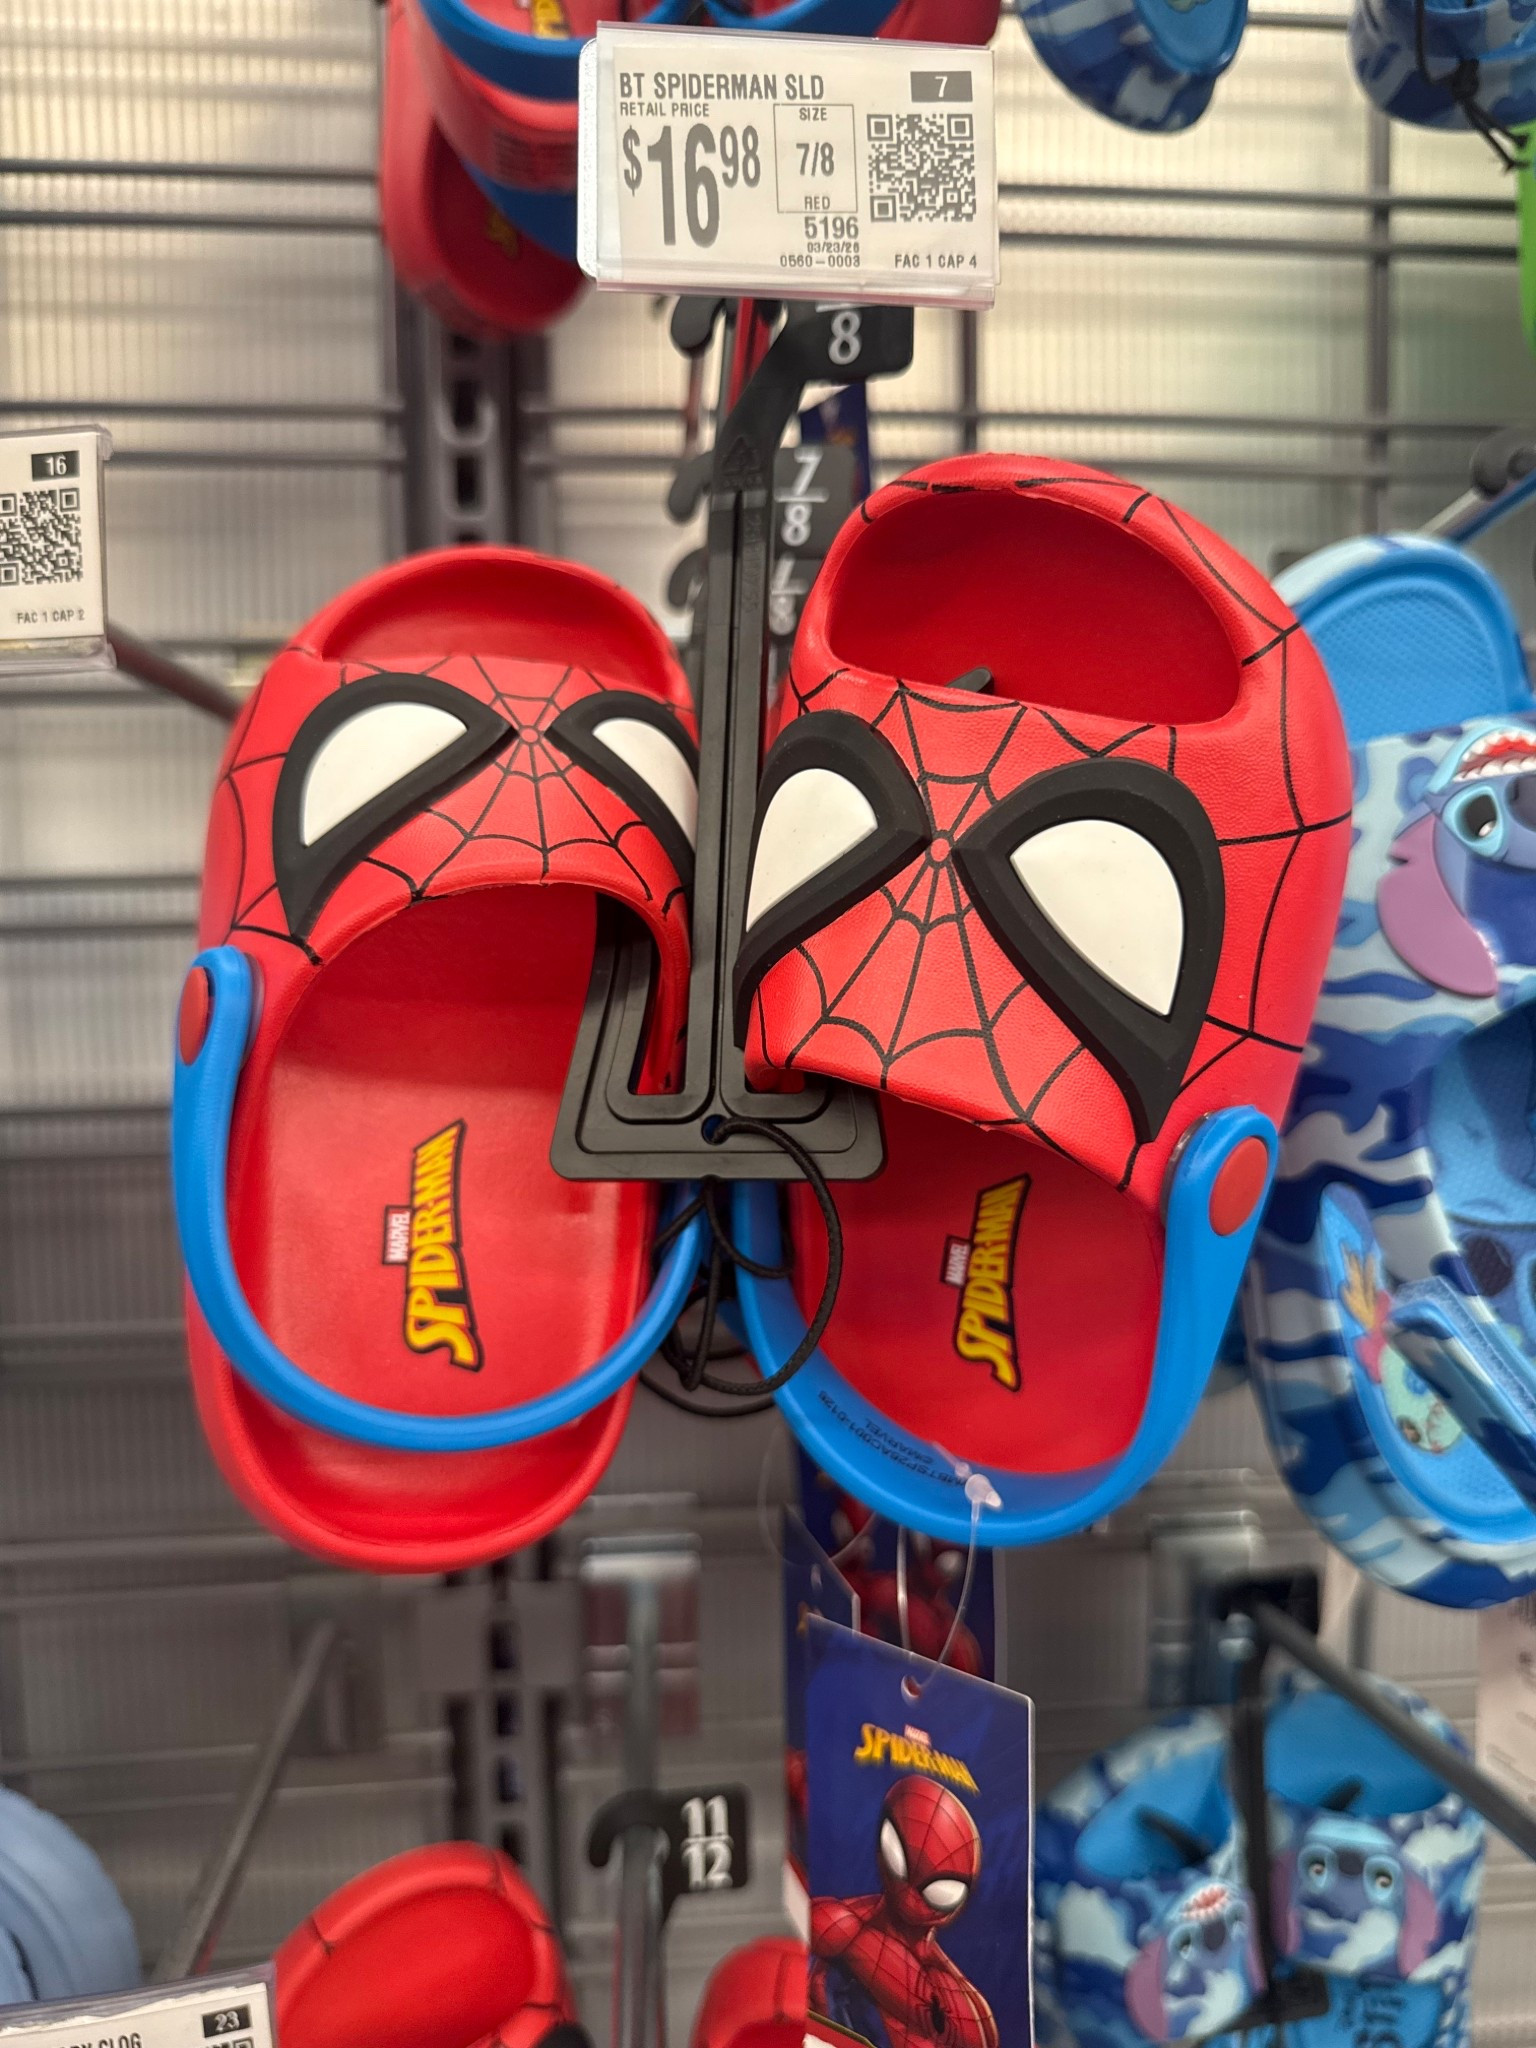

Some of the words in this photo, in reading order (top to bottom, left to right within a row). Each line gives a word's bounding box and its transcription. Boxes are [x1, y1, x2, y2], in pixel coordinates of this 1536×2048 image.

[620, 73, 645, 99] BT
[654, 73, 777, 100] SPIDERMAN
[785, 75, 824, 100] SLD
[934, 76, 948, 98] 7
[620, 102, 667, 117] RETAIL
[671, 104, 709, 118] PRICE
[799, 107, 827, 121] SIZE
[796, 142, 834, 178] 7/8
[804, 196, 830, 210] RED
[804, 216, 858, 239] 5196
[895, 255, 920, 269] FAC
[925, 255, 932, 268] 1
[938, 255, 965, 269] CAP
[969, 255, 977, 269] 4
[828, 310, 862, 366] 8
[46, 454, 67, 477] 16
[781, 503, 811, 546] 8
[17, 612, 38, 624] FAC
[42, 612, 48, 623] 1
[53, 610, 74, 622] CAP
[78, 609, 85, 621] 2
[387, 1210, 410, 1263] MARVEL
[681, 1795, 729, 1837] 11
[682, 1840, 733, 1890] 12
[213, 2011, 240, 2032] 23
